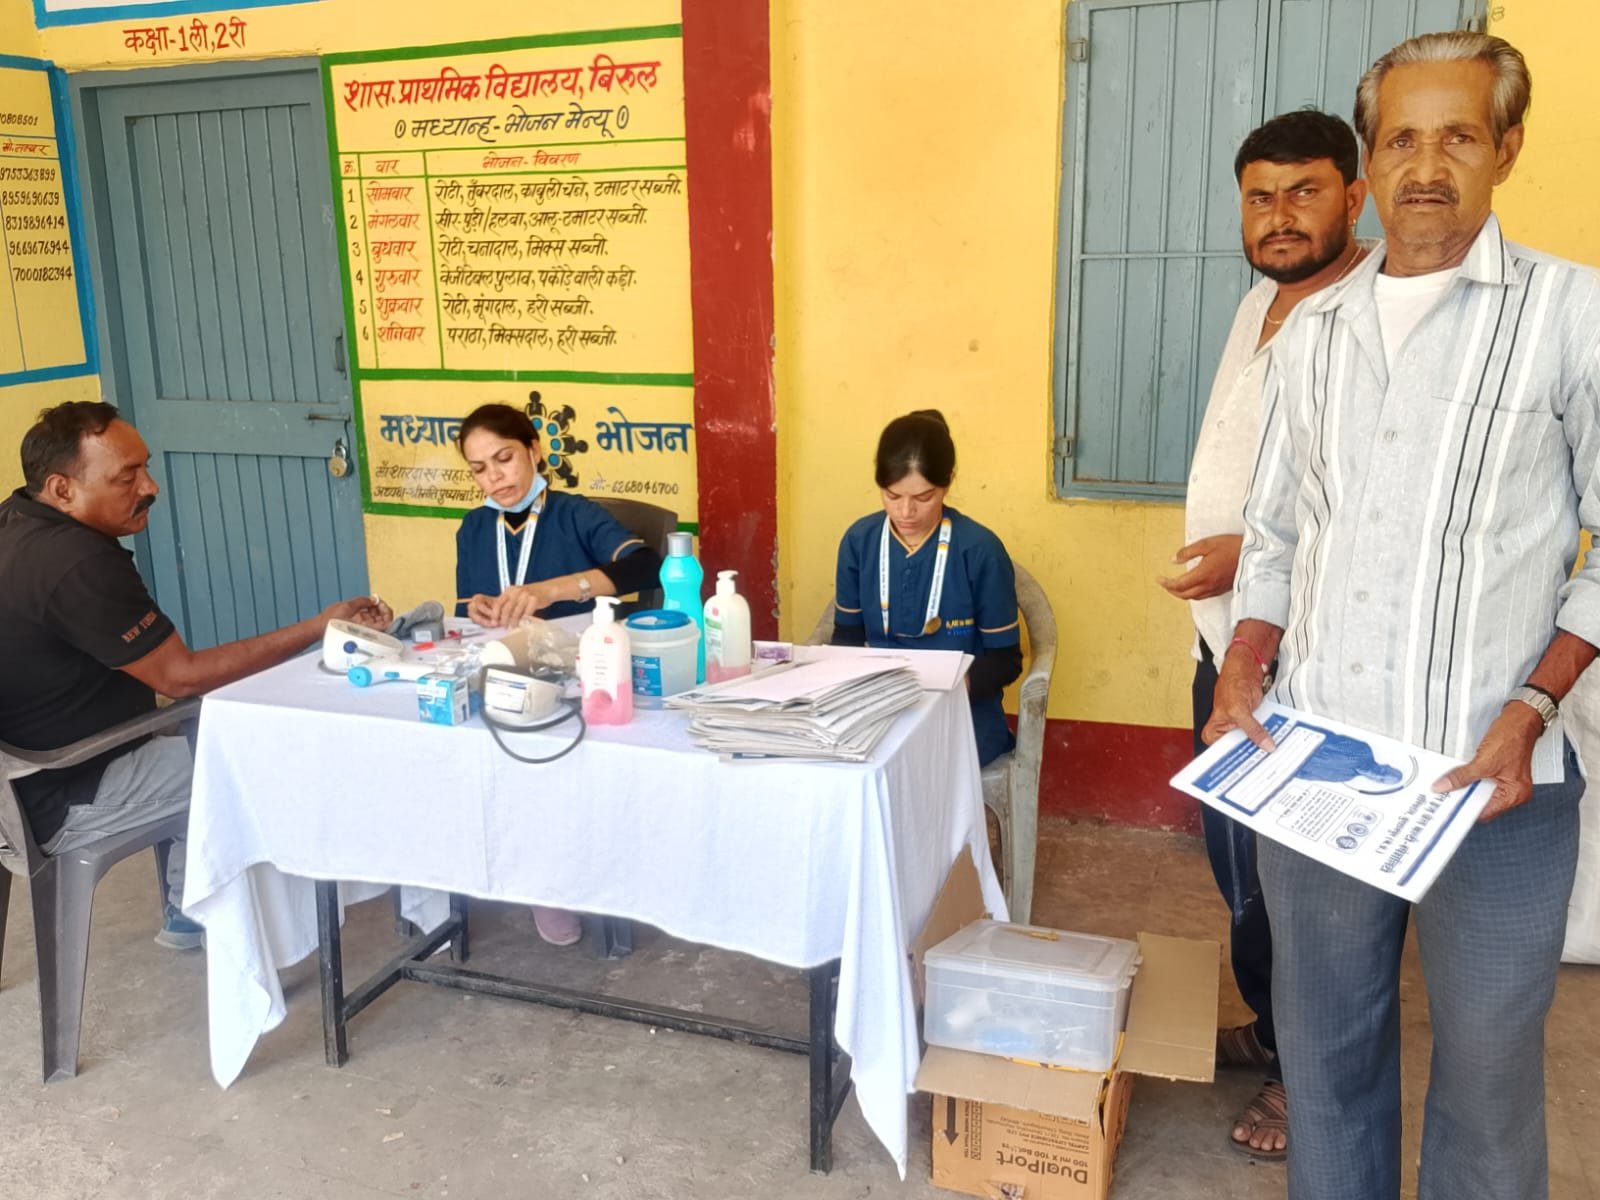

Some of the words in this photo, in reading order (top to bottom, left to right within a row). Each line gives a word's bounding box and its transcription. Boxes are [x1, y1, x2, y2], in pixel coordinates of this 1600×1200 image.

[375, 159, 401, 175] वार
[347, 188, 355, 203] 1
[366, 180, 415, 206] सोमवार
[350, 213, 359, 230] 2
[367, 209, 421, 231] मंगलवार
[352, 241, 361, 257] 3
[370, 240, 418, 264] बुधवार
[525, 234, 567, 261] मिक्स
[356, 269, 364, 286] 4
[360, 299, 368, 315] 5
[375, 296, 425, 321] शुक्रवार
[526, 293, 549, 323] हरी
[376, 321, 427, 346] शनिवार
[556, 324, 579, 355] हरी
[595, 406, 693, 455] भोजन
[1033, 1149, 1050, 1159] 100
[1072, 1159, 1089, 1168] 100
[995, 1150, 1088, 1185] DualPort
